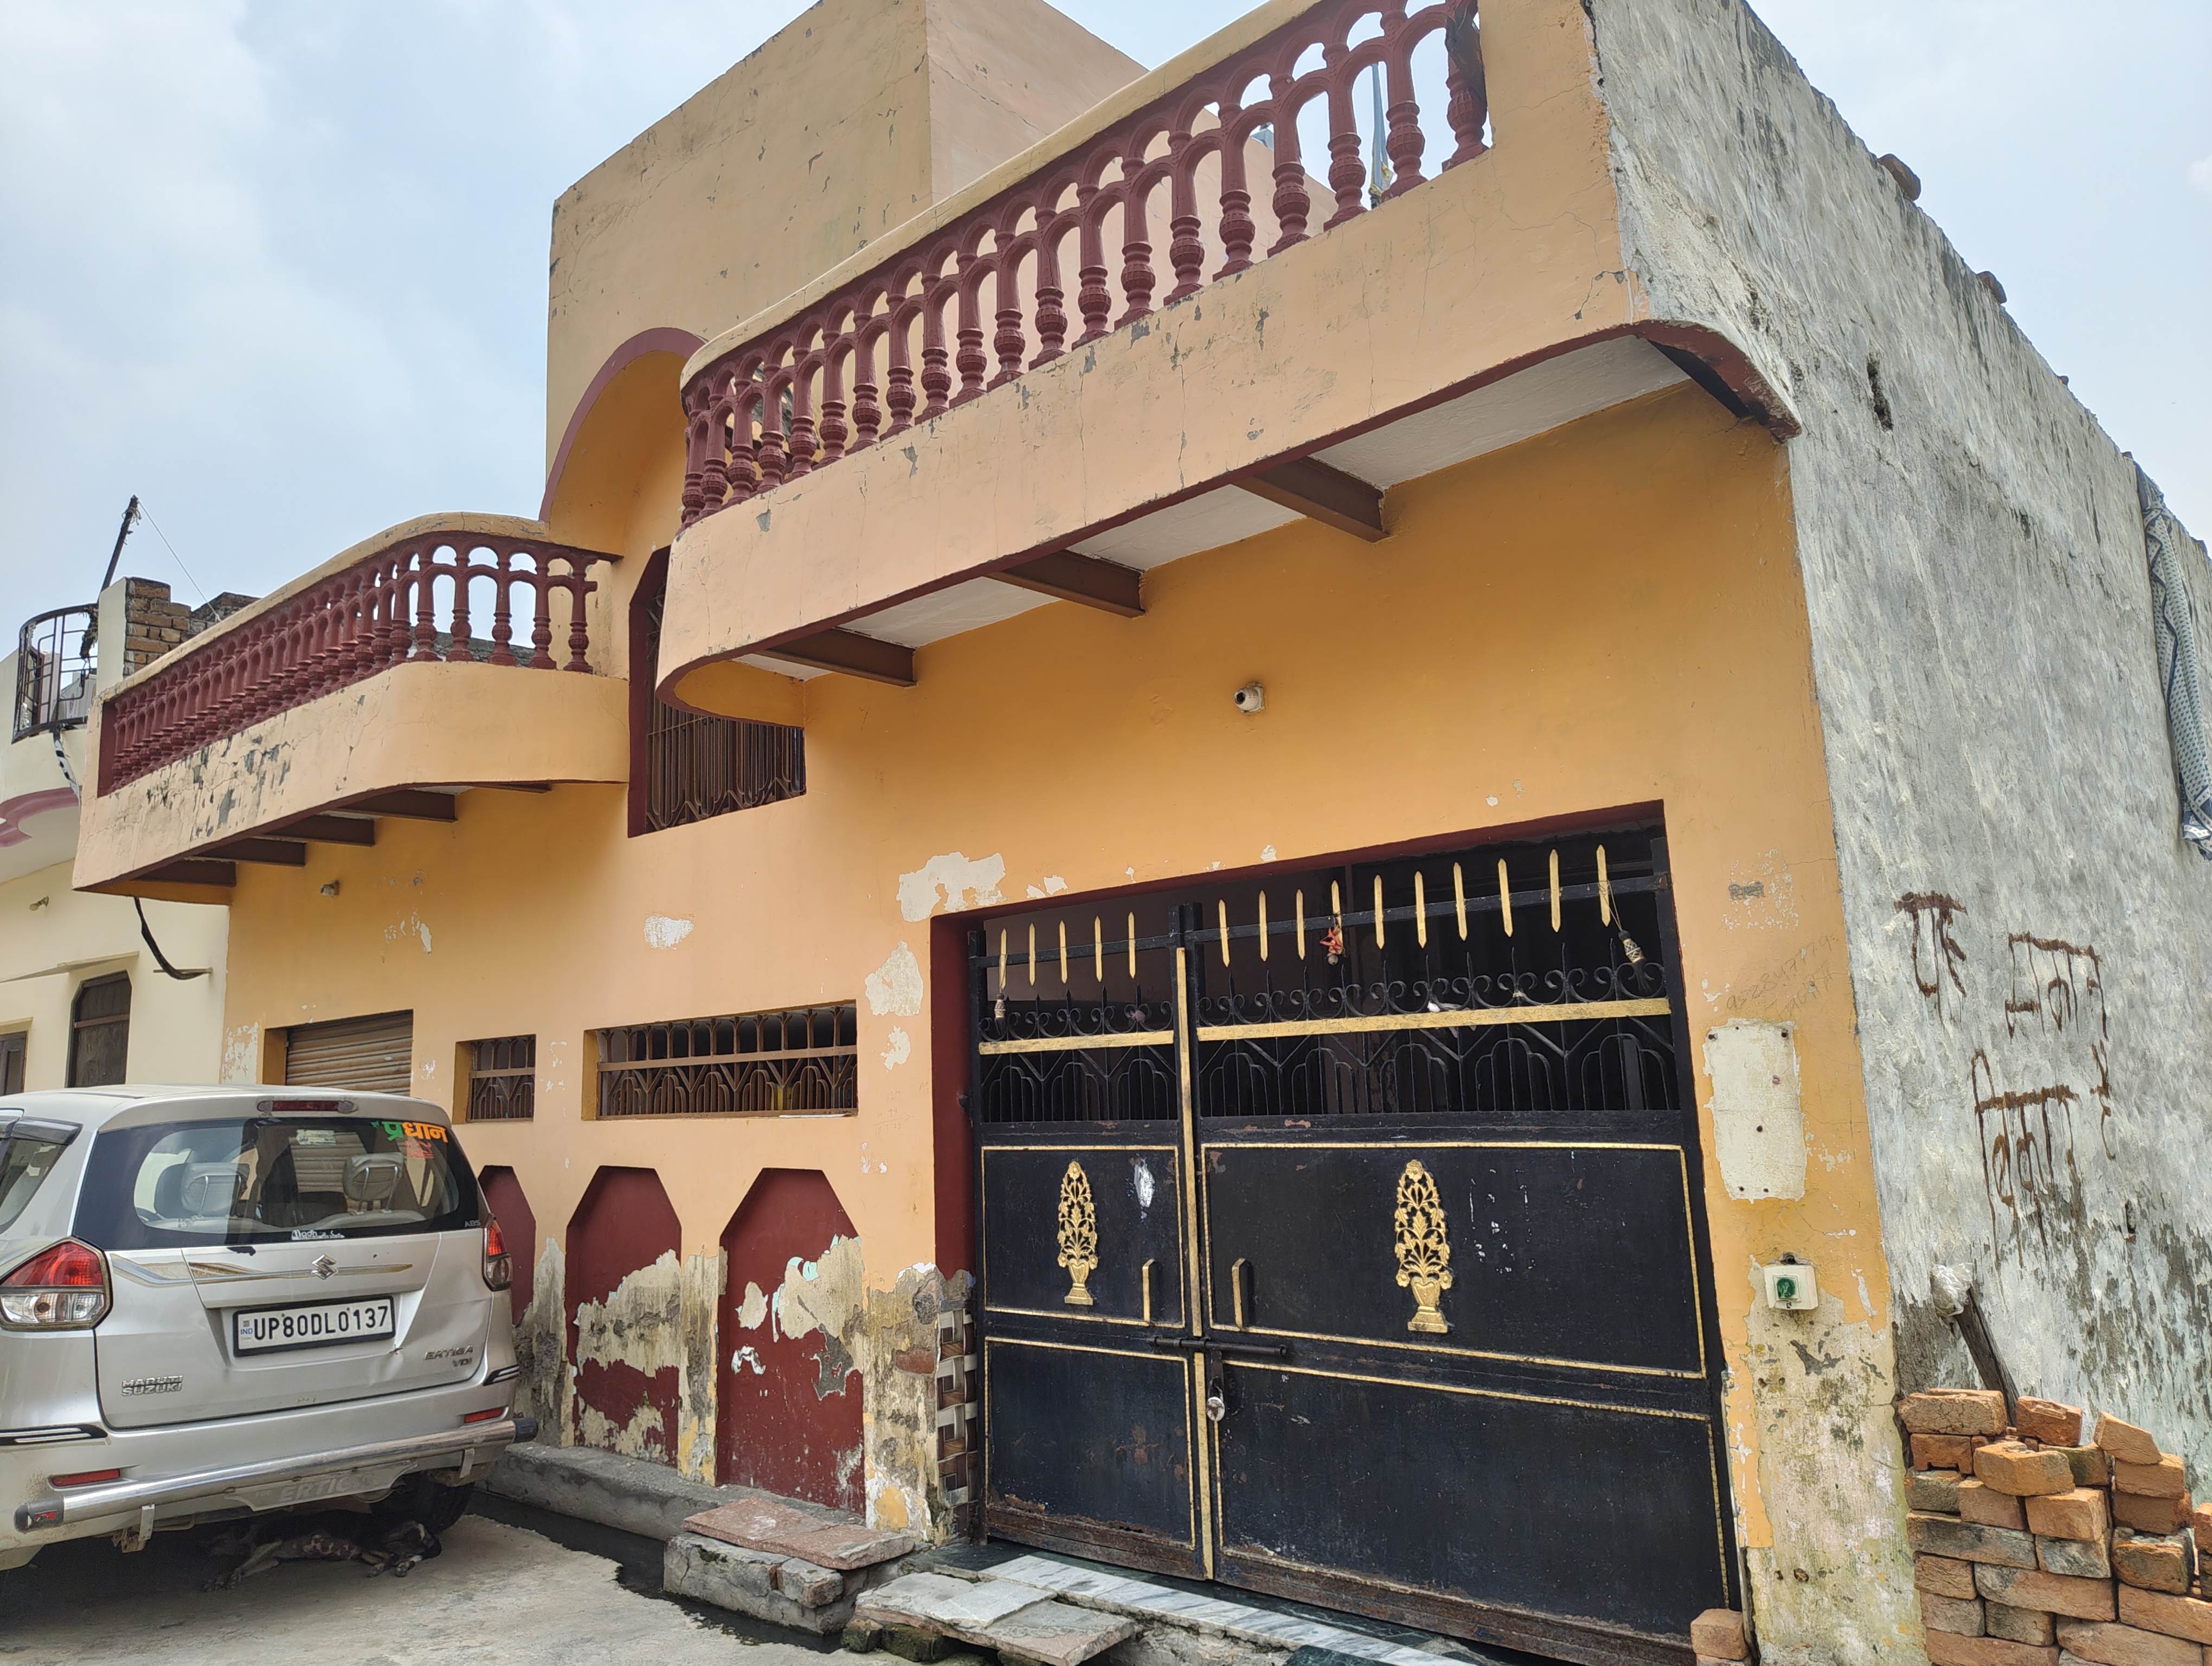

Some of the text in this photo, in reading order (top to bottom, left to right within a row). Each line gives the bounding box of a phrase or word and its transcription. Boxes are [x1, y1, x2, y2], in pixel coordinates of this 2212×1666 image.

[381, 1120, 448, 1143] प्रधान
[254, 1306, 388, 1341] UP80DL0137
[425, 1345, 473, 1360] ERTIGA
[121, 1375, 183, 1387] MARUTI
[121, 1383, 182, 1396] SUZUKI
